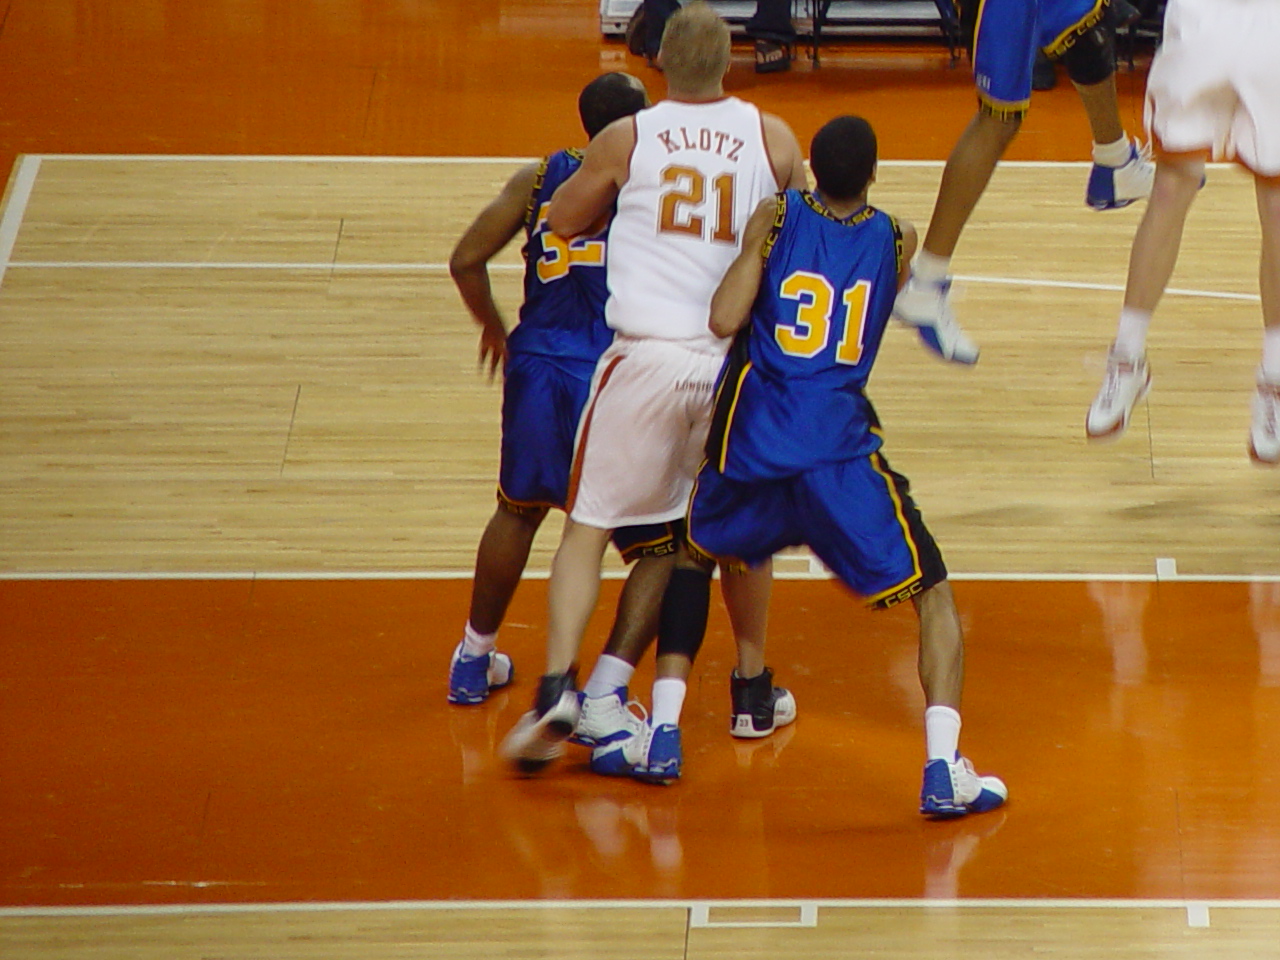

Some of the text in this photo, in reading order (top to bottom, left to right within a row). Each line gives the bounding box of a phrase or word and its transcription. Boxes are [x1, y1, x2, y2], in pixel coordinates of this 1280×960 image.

[656, 126, 746, 162] KLOTZ
[656, 164, 739, 247] 21
[774, 269, 872, 367] 31
[884, 581, 924, 609] CSC
